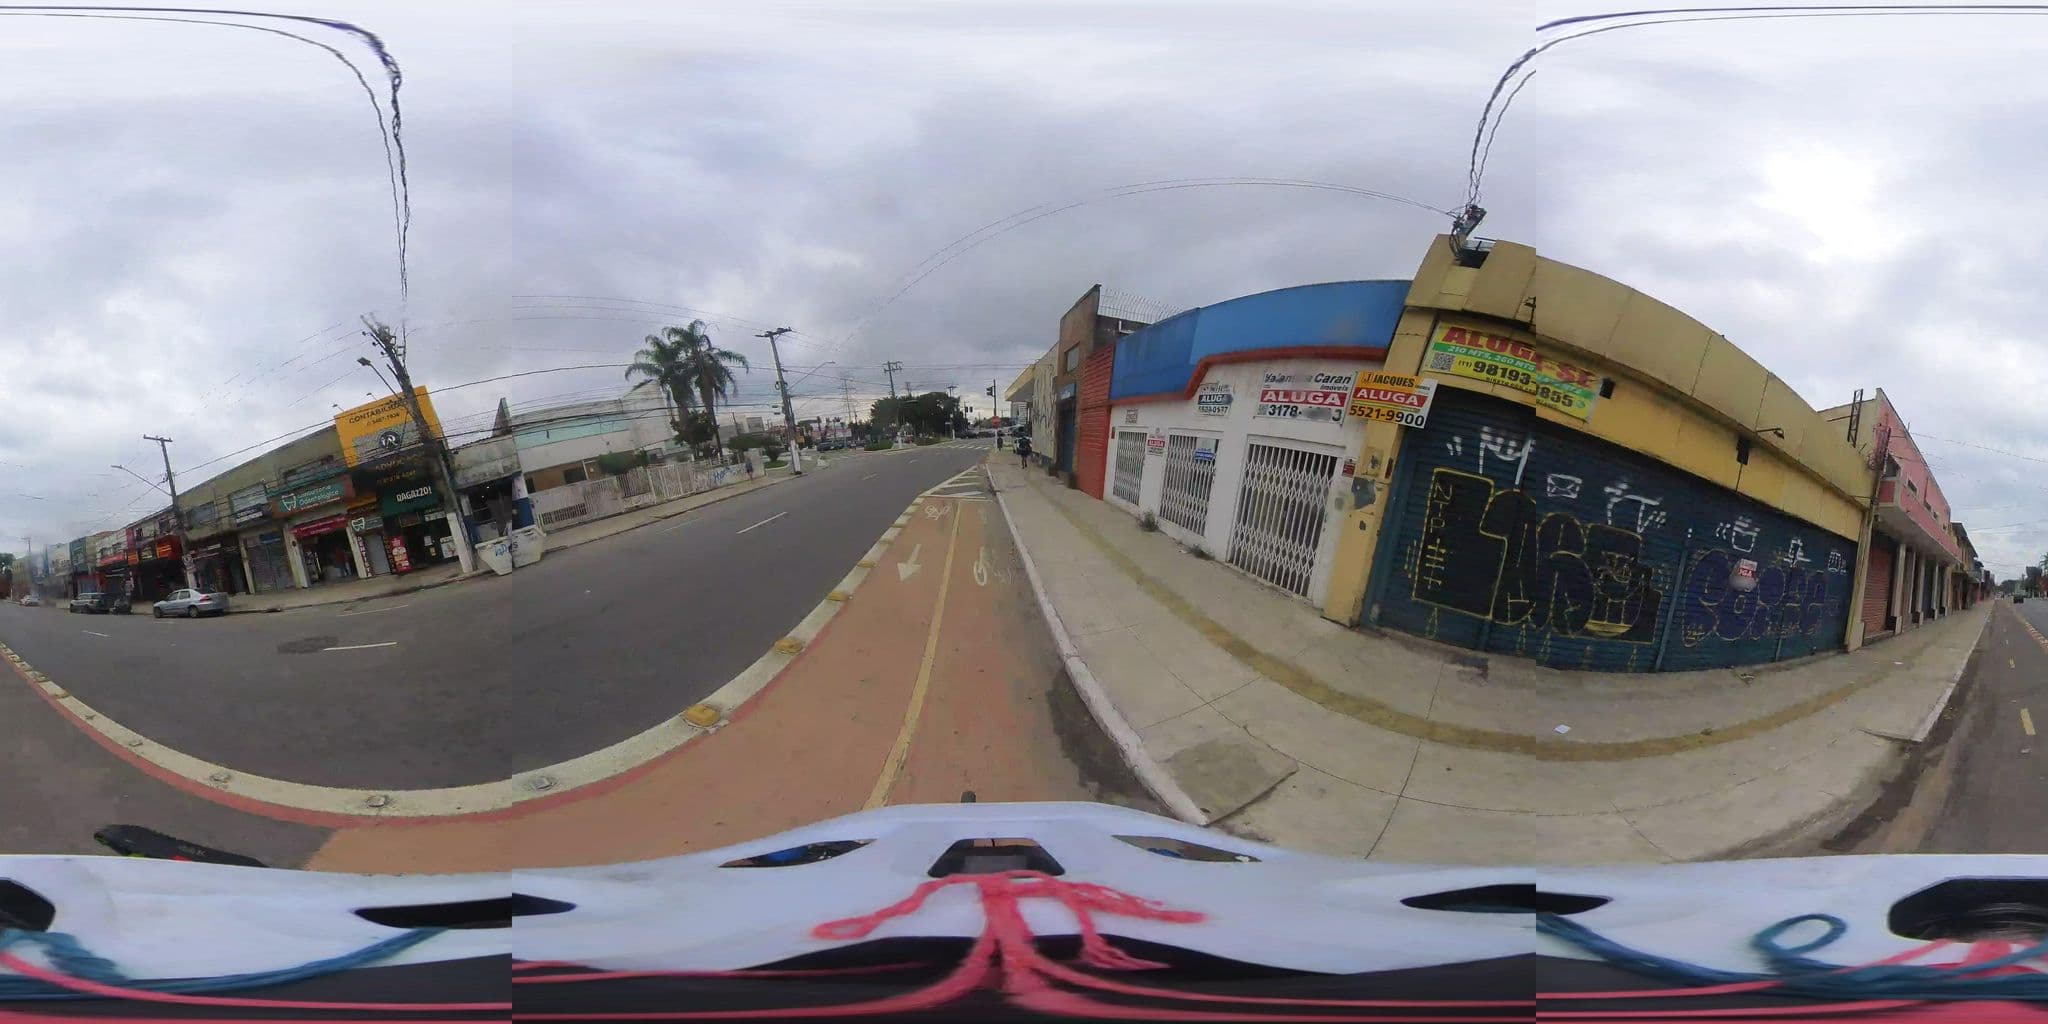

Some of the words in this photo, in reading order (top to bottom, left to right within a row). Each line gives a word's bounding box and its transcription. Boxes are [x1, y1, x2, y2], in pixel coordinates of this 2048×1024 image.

[1442, 326, 1593, 388] ALUG-SE
[1473, 361, 1573, 407] 98193-855
[1263, 391, 1342, 405] ALUGA
[1356, 389, 1419, 406] ALUGA
[1268, 404, 1342, 422] 3178-3
[1349, 405, 1425, 427] 5521-9900
